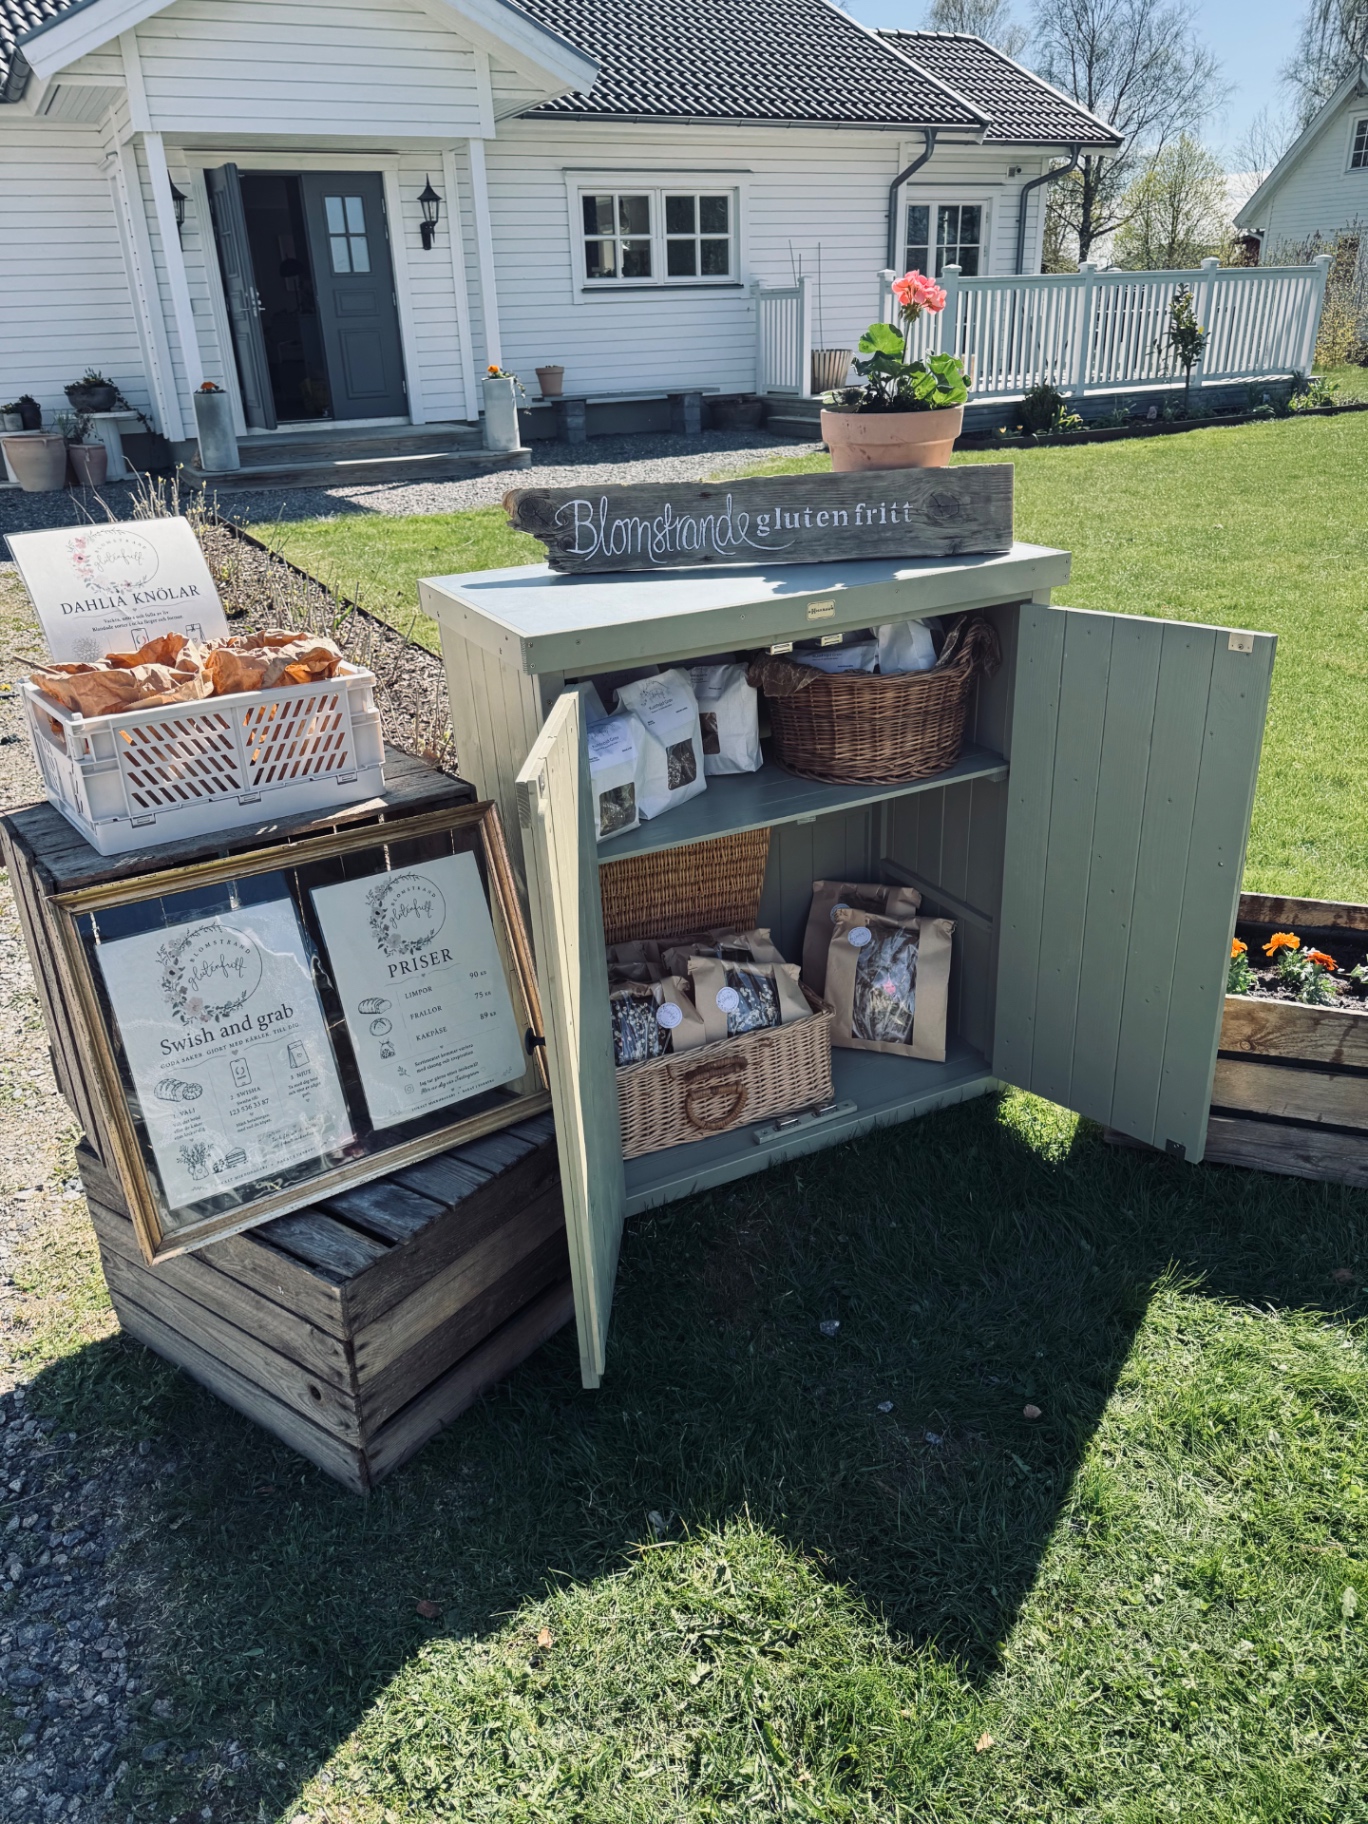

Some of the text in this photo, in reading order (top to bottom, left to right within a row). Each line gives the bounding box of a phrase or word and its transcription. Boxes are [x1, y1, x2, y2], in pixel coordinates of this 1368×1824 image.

[60, 584, 201, 616] DAHLIA KNÖLAR
[190, 939, 251, 963] BLOMSTRAND
[388, 948, 453, 978] PRISER
[404, 985, 433, 999] LIMPOR
[468, 970, 479, 979] 90
[408, 1005, 443, 1020] FRALLOR
[473, 991, 483, 999] 75
[160, 1004, 294, 1055] Swish and grab
[414, 1025, 448, 1041] KAKPÅSE
[478, 1011, 489, 1020] 89
[159, 1059, 180, 1069] GODA
[228, 1039, 244, 1048] MED
[296, 1068, 312, 1078] NJUT
[236, 1085, 261, 1097] SWISHA
